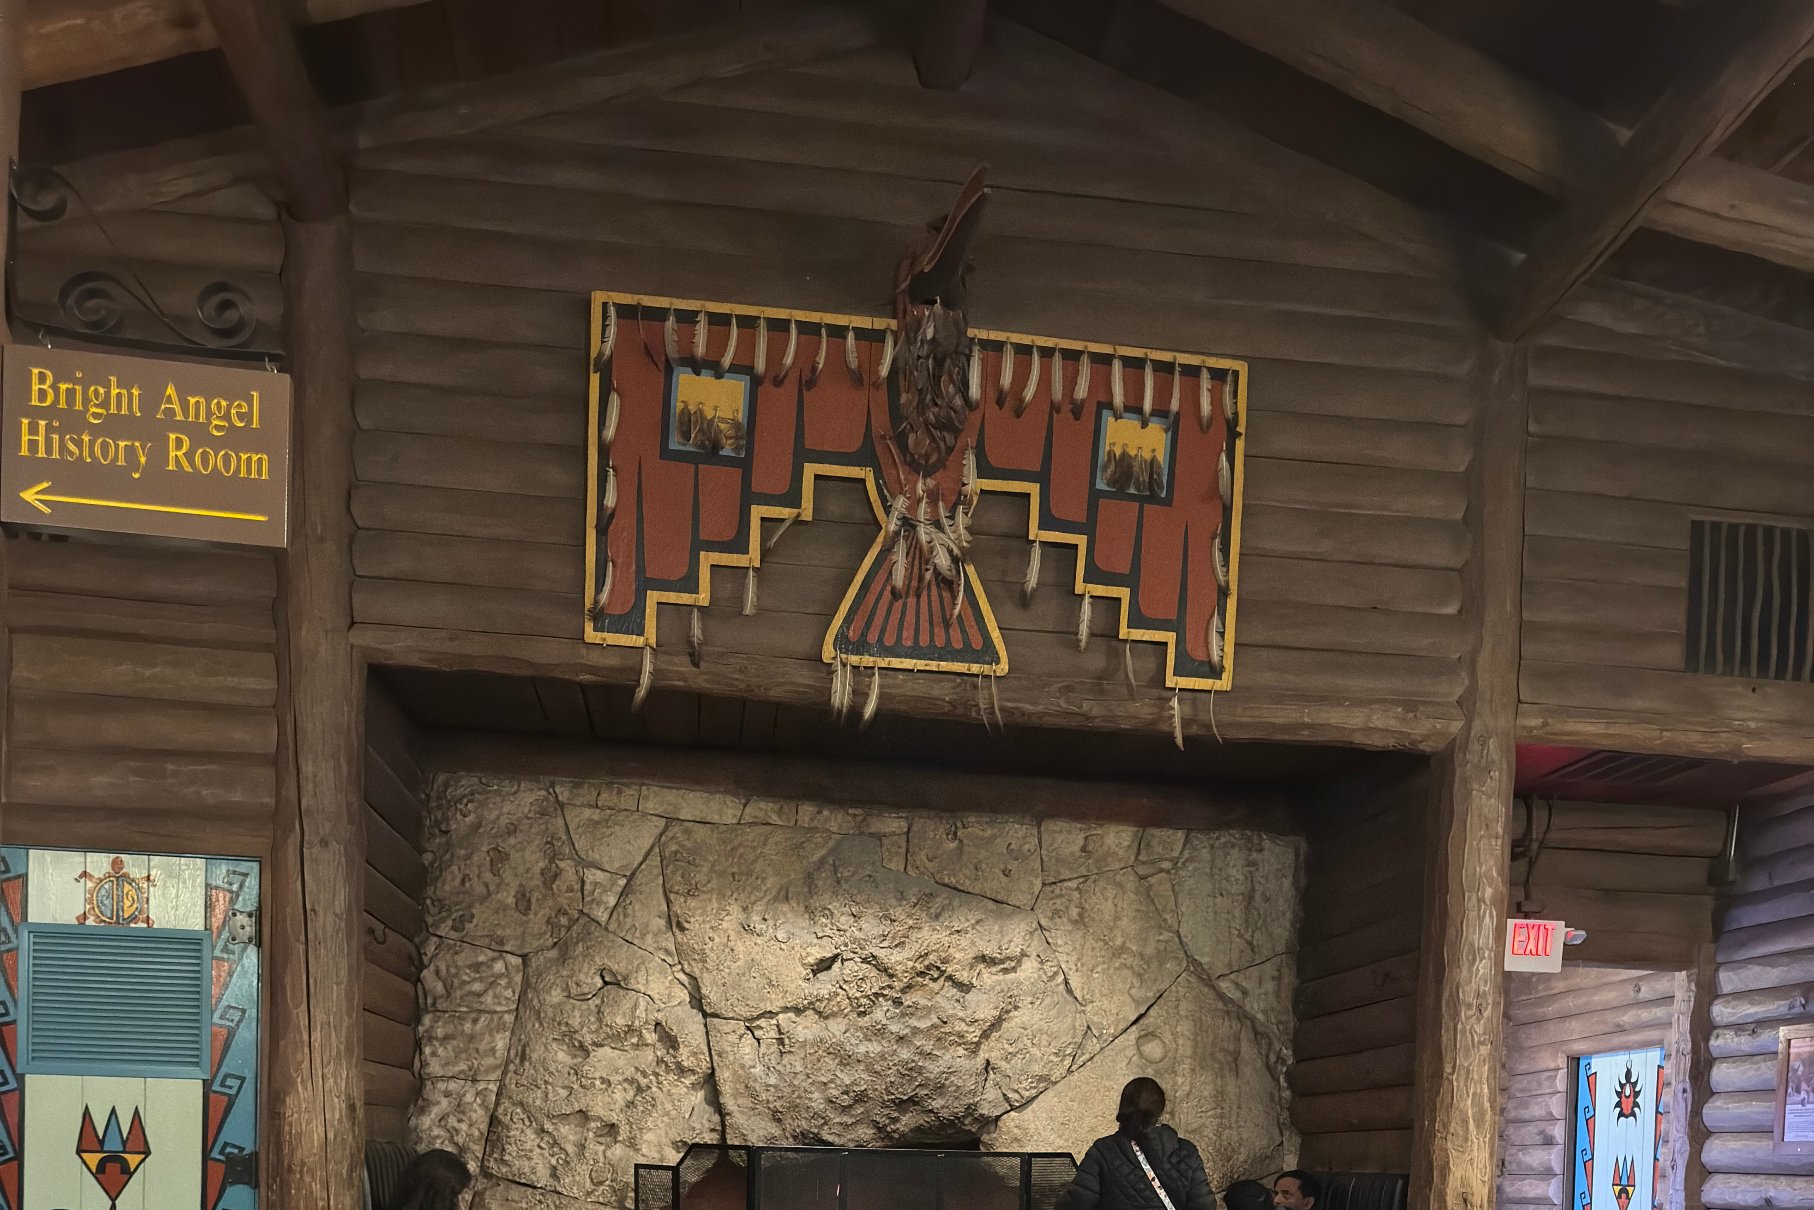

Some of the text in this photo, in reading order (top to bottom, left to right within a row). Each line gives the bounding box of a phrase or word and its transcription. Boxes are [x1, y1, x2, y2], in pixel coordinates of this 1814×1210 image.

[27, 366, 261, 436] Bright Angel
[18, 418, 270, 480] History Room
[1512, 923, 1556, 956] EXIT
